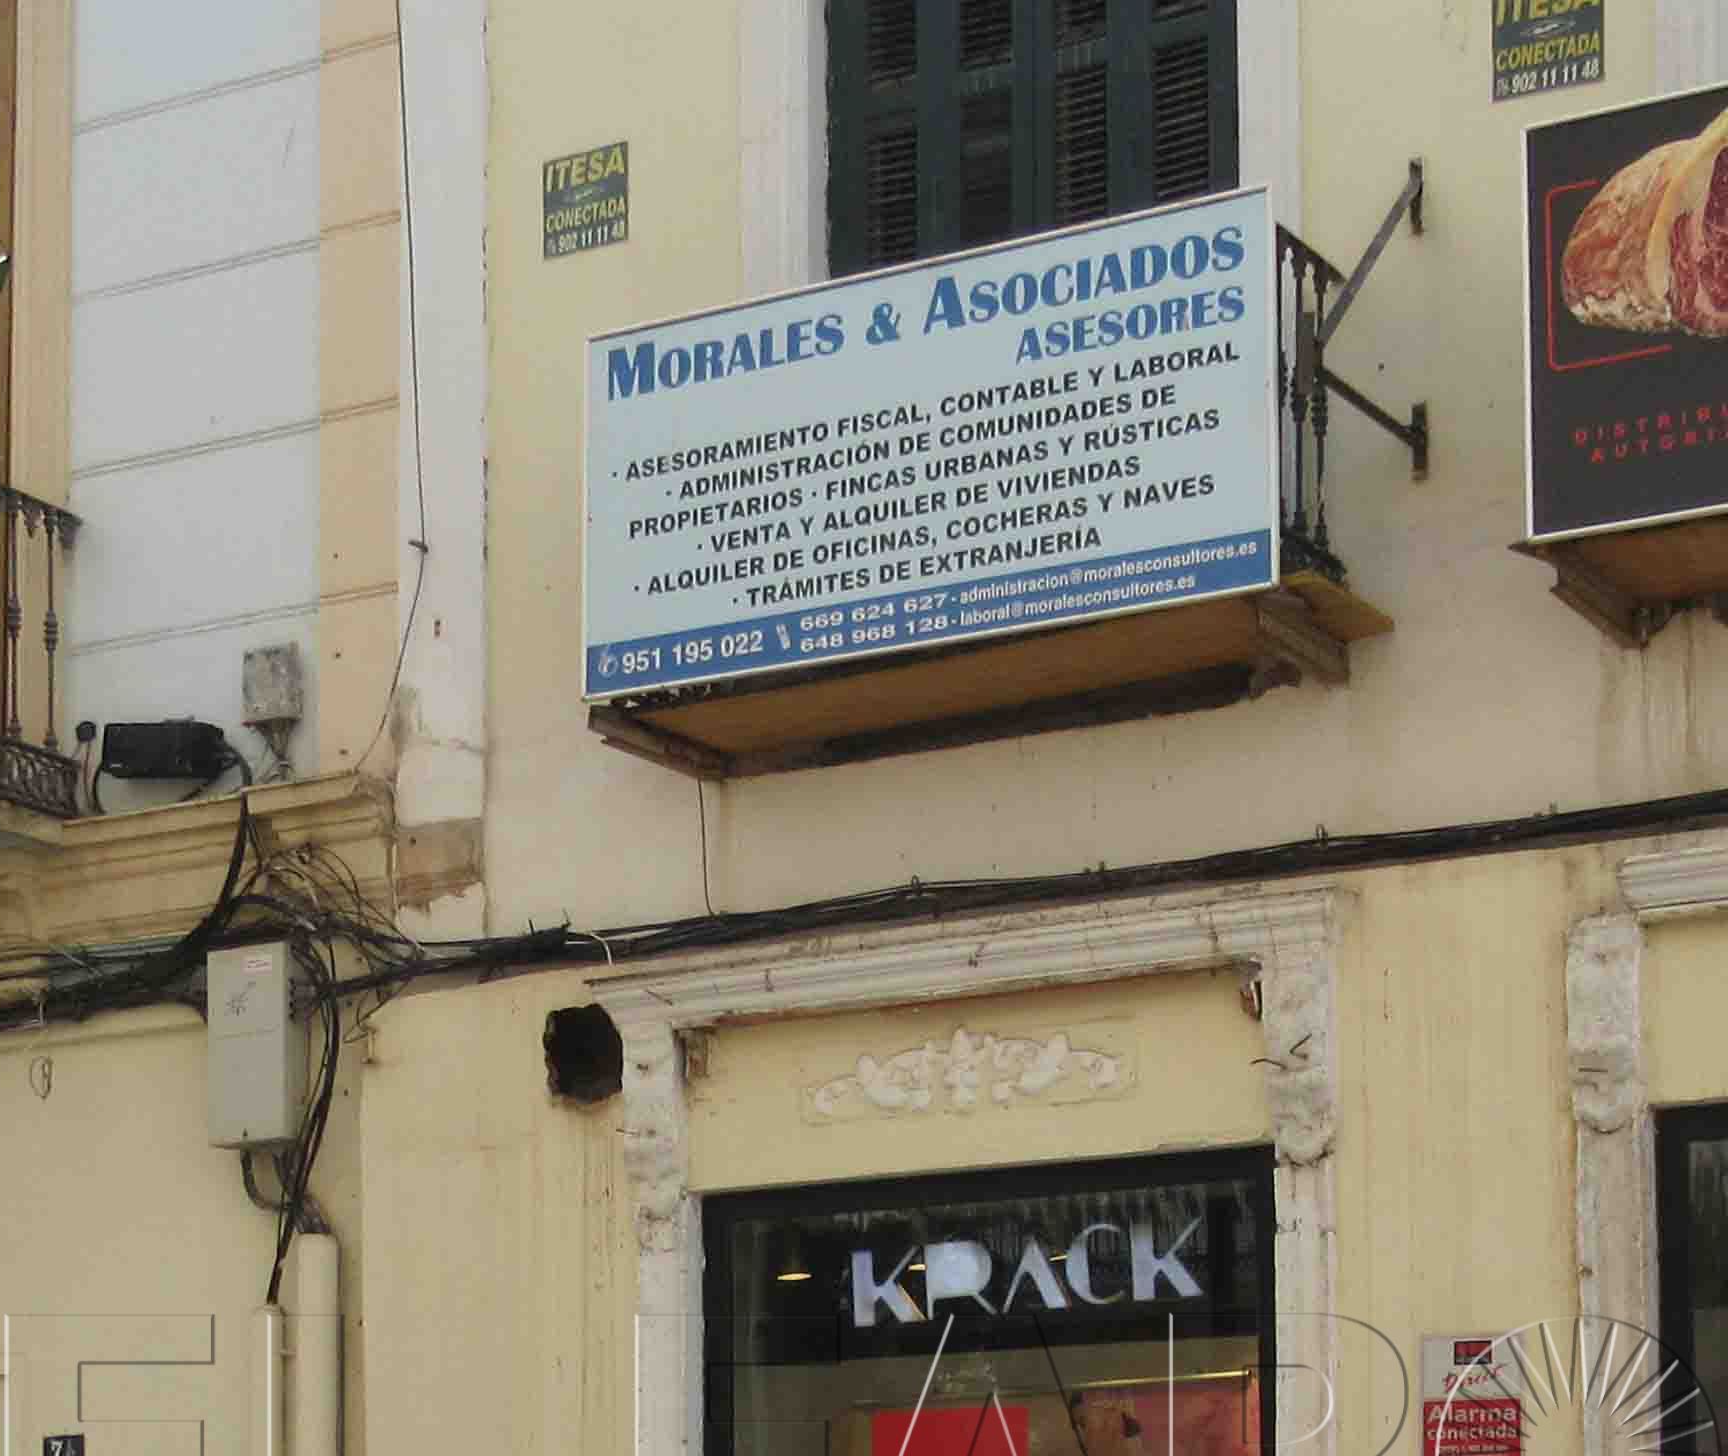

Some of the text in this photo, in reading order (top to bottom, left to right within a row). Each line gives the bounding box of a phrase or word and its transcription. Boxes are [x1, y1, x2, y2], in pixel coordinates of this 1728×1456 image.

[1497, 28, 1600, 71] CONECTADA
[1512, 73, 1537, 94] 902
[546, 146, 624, 192] ITESA
[546, 197, 624, 233] CONECTADA
[607, 226, 1246, 401] MORALES & ASOCIADOS
[1015, 286, 1246, 366] ASESORES
[625, 341, 1241, 482] ASESORAMIENTO FISCAL, CONTABLE Y LABORAL
[679, 384, 1177, 499] ADMINISTRACIÓN DE COMUNIDADES DE
[628, 408, 1221, 540] PROPIETARIOS FINCAS URBANAS Y RÚSTICAS
[710, 456, 1142, 553] VENTA Y ALQUILER DE VIVIENDAS
[647, 474, 1216, 596] ALQUILER DE OFICINAS, COCHERAS Y NAVES
[747, 525, 1103, 608] TRÁMITES DE EXTRANJERÍA
[622, 630, 765, 675] 951 195 022
[800, 612, 844, 632] 669
[851, 603, 896, 624] 624
[903, 593, 947, 616] 627
[800, 632, 844, 653] 648
[851, 624, 896, 645] 968
[904, 614, 949, 637] 128
[849, 1216, 1204, 1328] KRACK
[1427, 1404, 1518, 1423] Alarma
